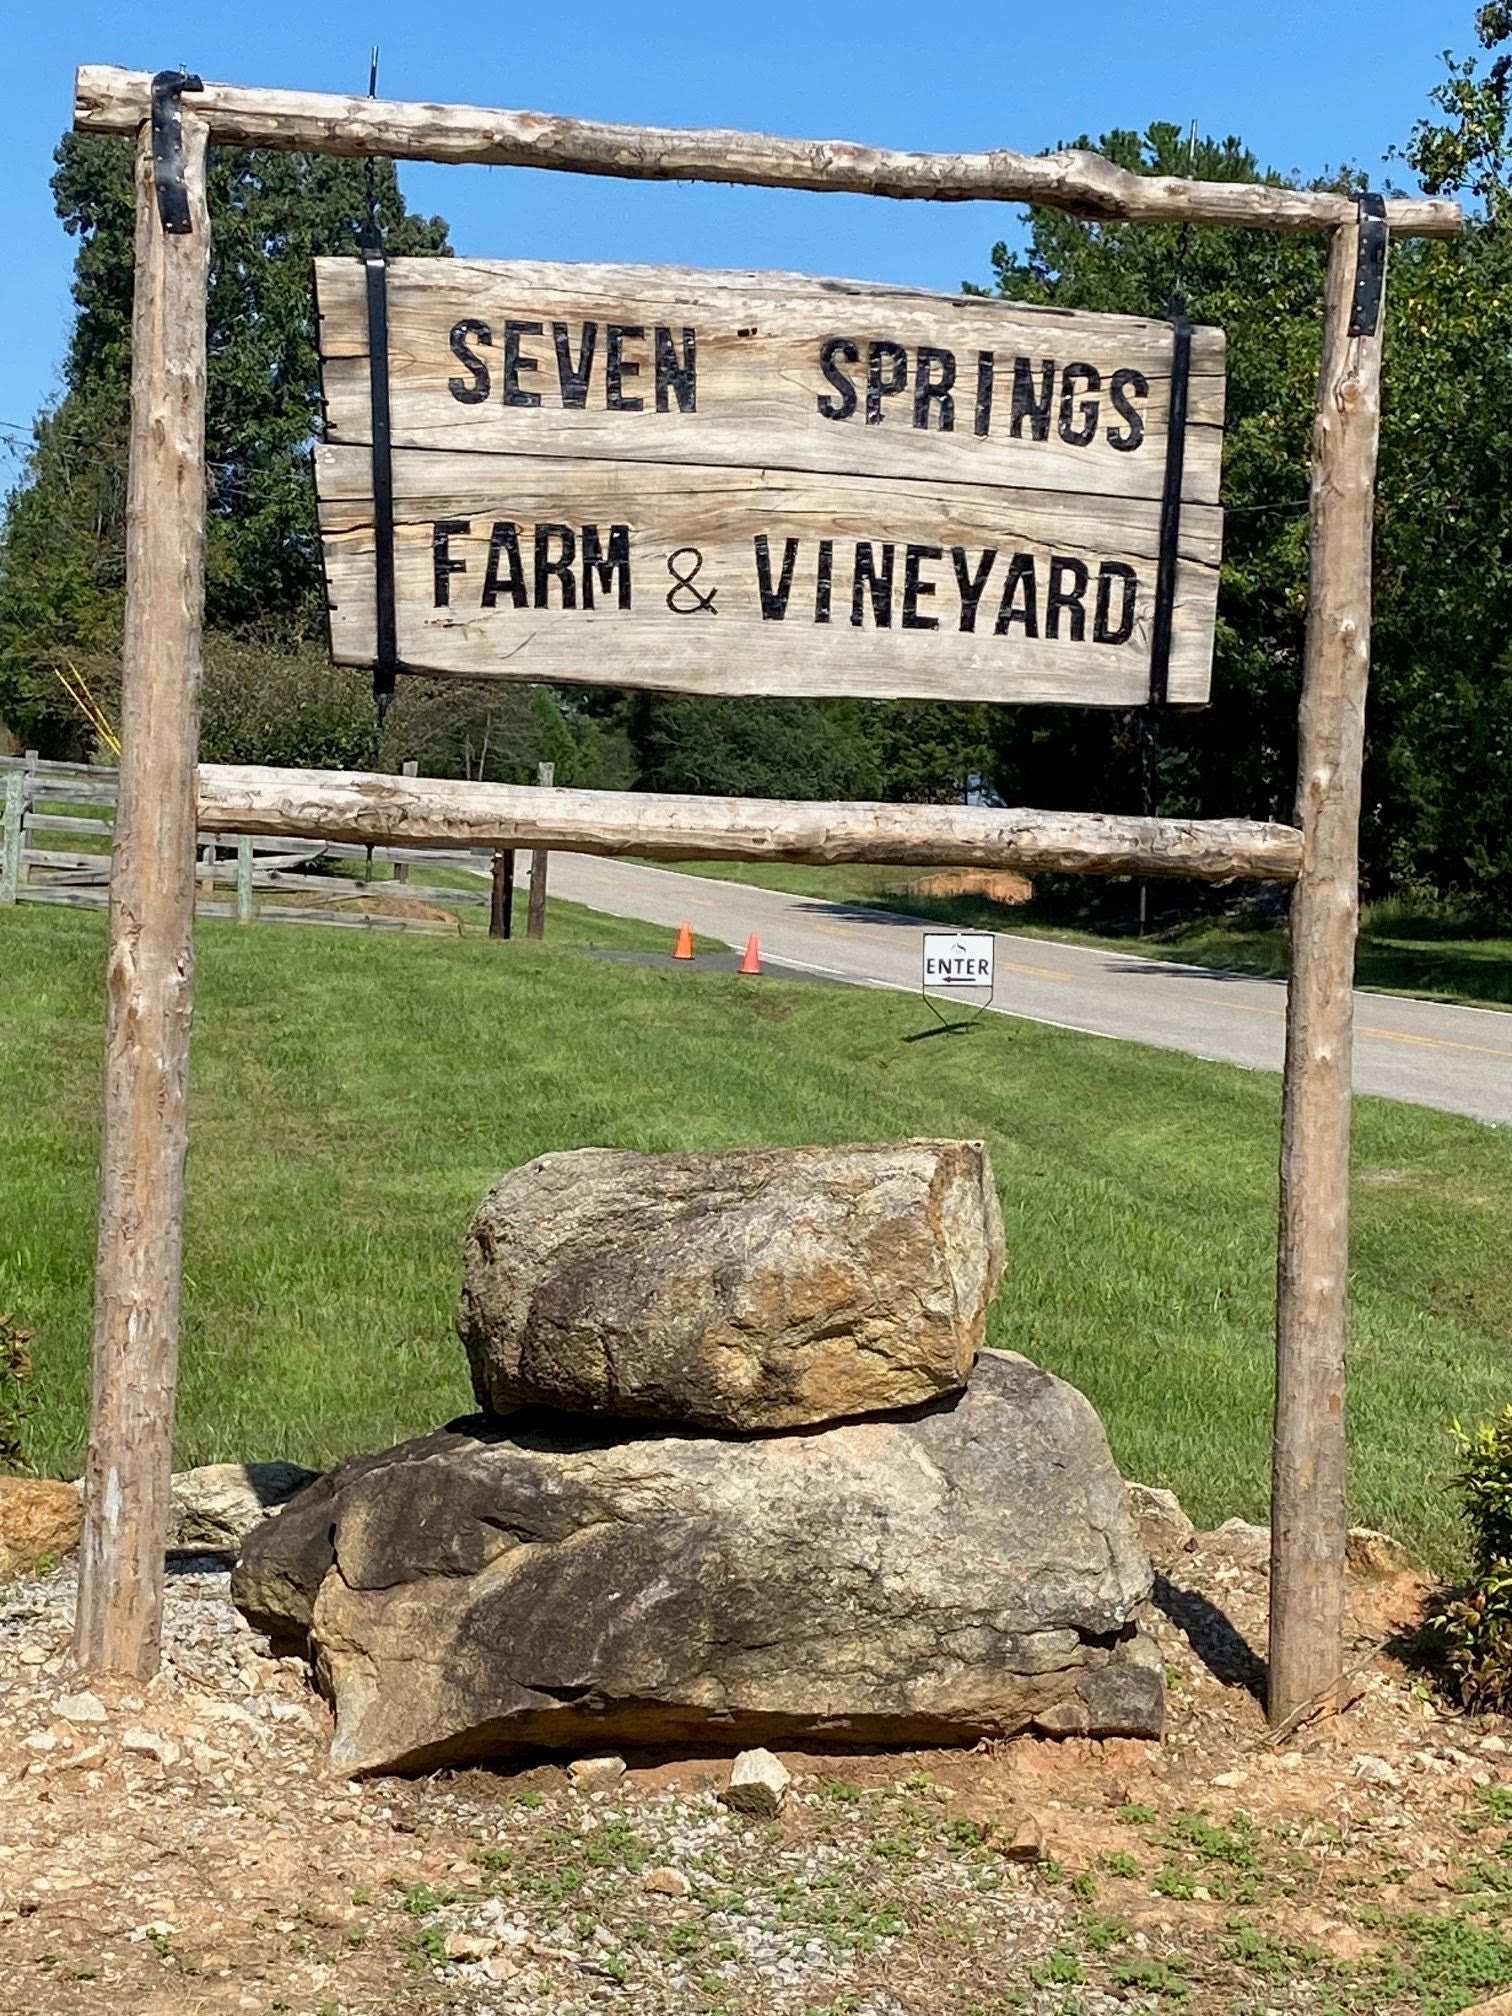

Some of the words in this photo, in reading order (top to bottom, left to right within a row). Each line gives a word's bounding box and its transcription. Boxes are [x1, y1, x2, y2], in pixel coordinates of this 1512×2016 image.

[448, 318, 697, 414] SEVEN
[817, 336, 1150, 452] SPRINGS
[432, 520, 632, 611] FARM
[665, 547, 719, 616] &
[753, 533, 1138, 646] VINEYARD
[926, 958, 989, 976] ENTER
